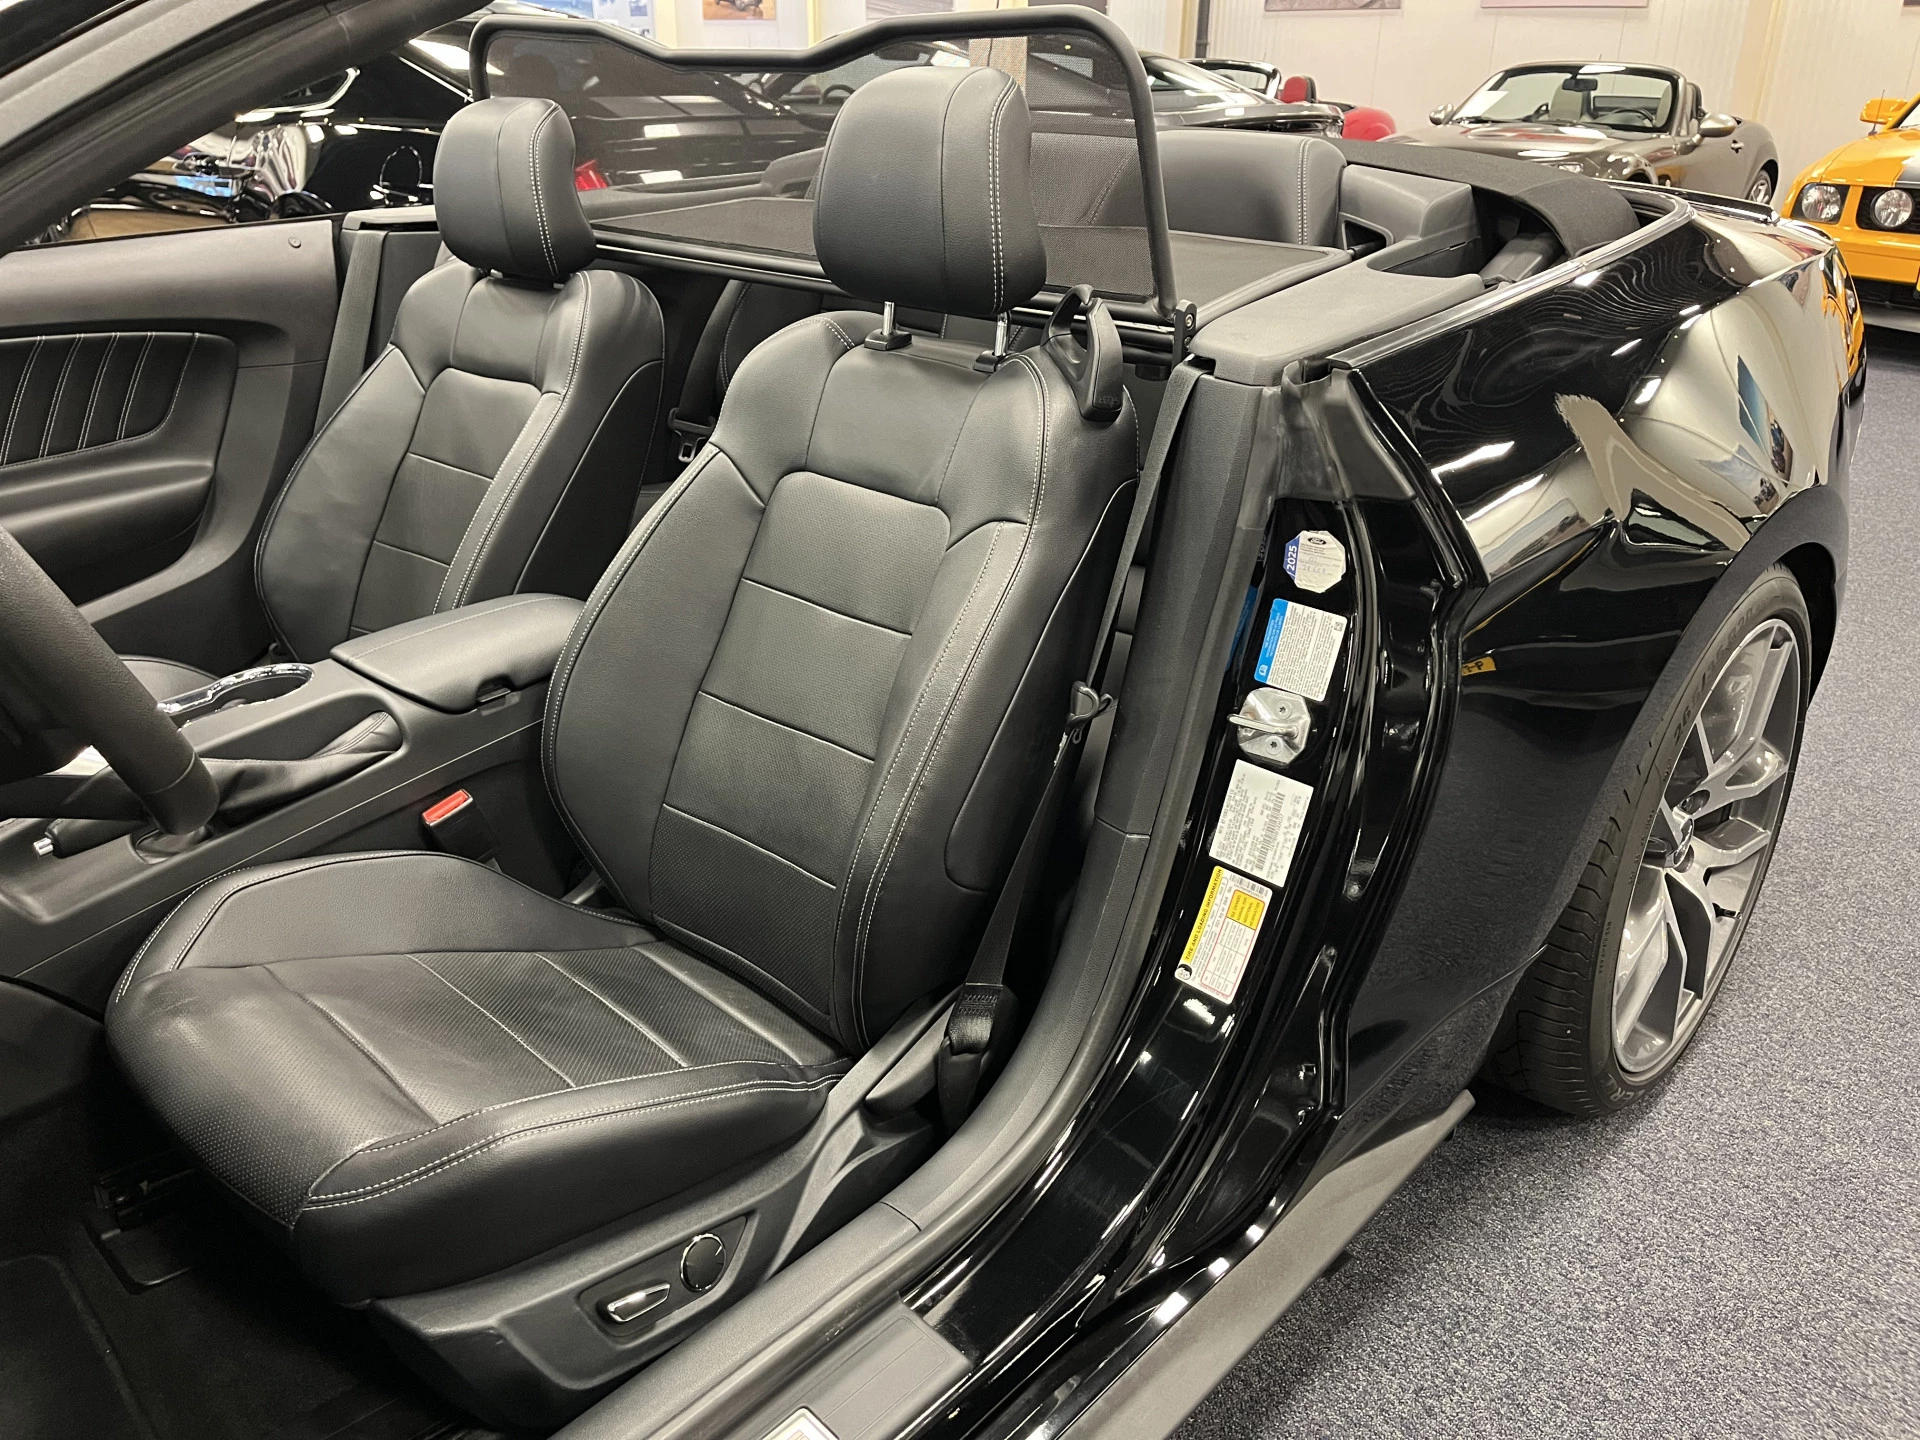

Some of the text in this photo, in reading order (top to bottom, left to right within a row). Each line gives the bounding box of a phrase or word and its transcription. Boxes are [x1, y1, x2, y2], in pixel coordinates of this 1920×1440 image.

[1286, 545, 1297, 571] 2025
[1185, 869, 1222, 960] TIRE AND LOADING INFORMATION
